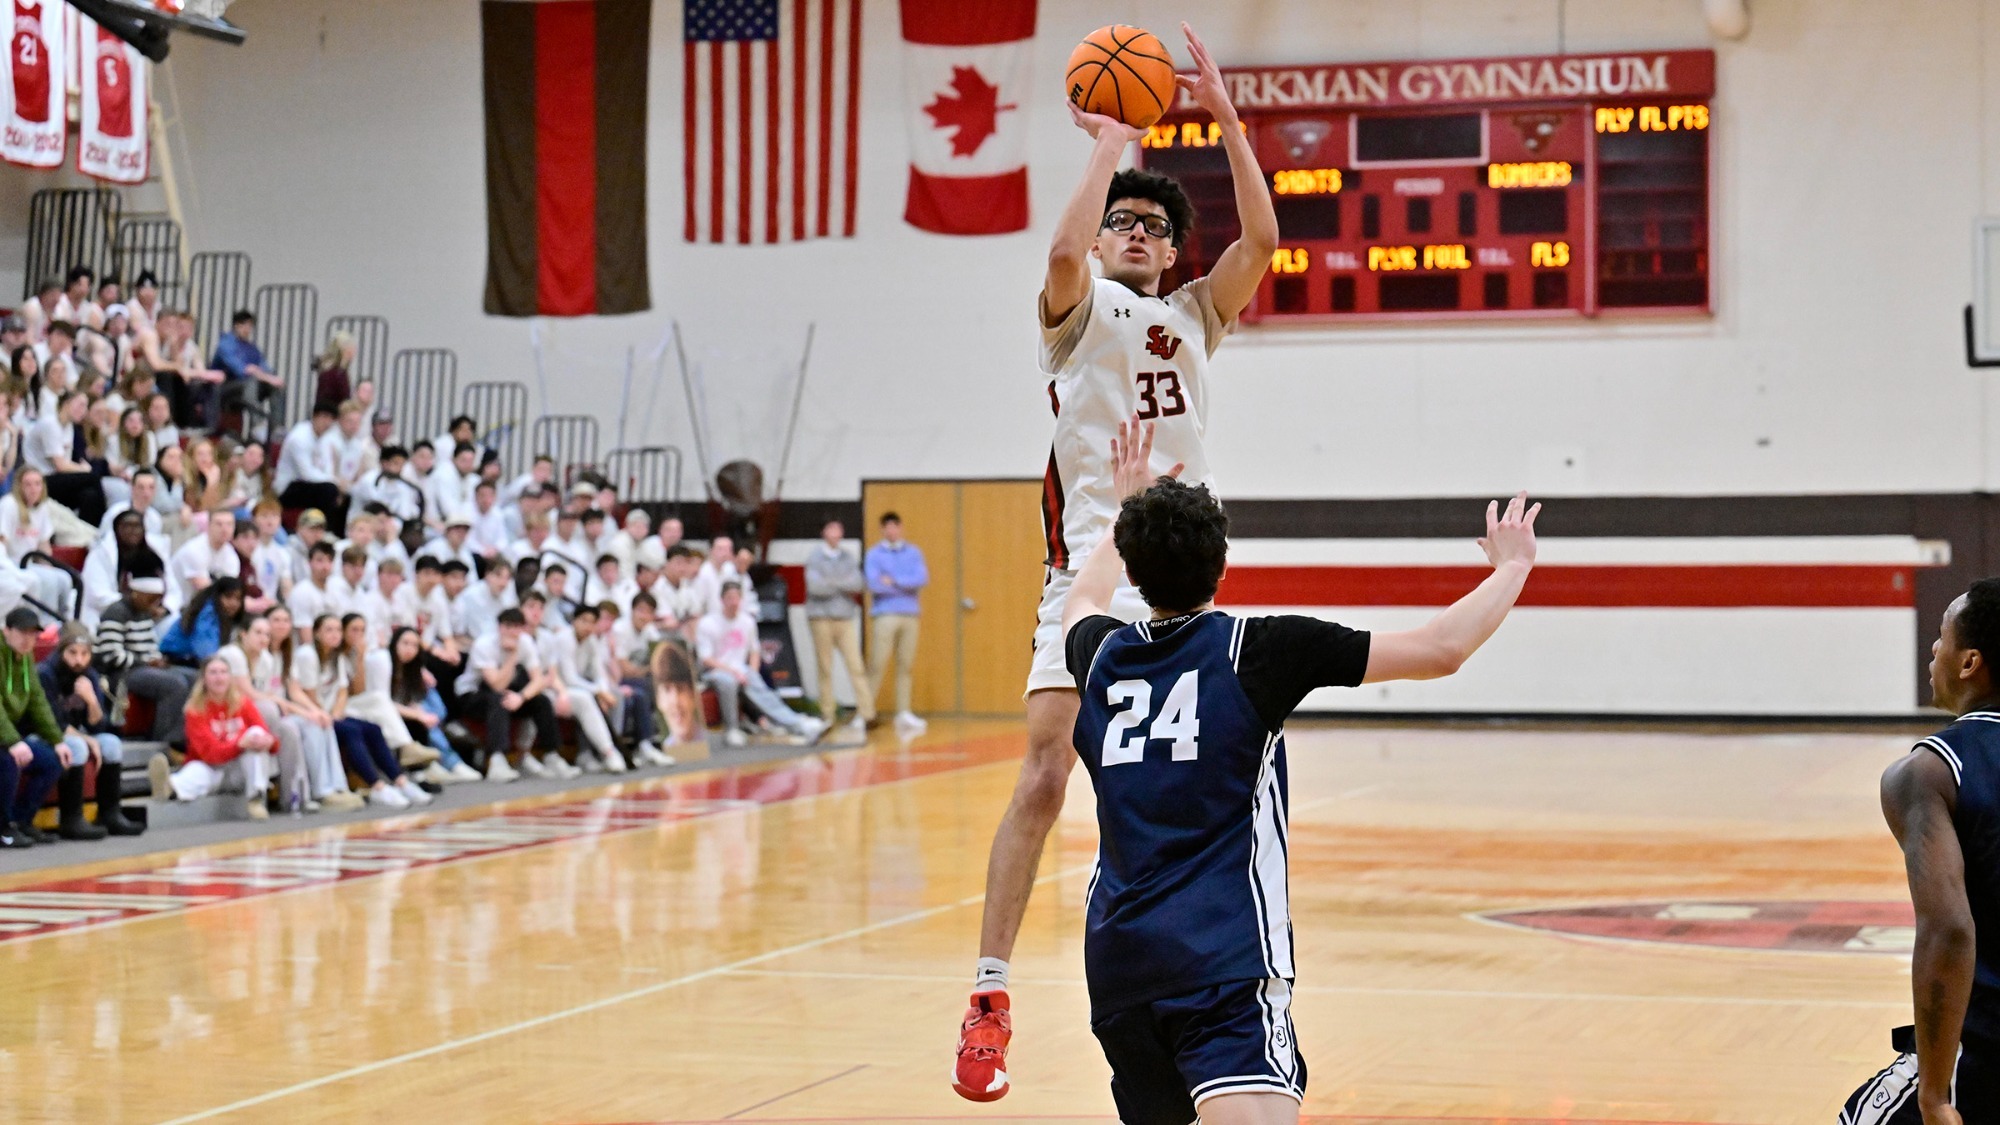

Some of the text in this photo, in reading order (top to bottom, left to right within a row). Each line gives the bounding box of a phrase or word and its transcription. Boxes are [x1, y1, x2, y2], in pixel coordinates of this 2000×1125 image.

[1399, 56, 1670, 100] GYMNASIUM
[1667, 105, 1709, 131] PTS
[1271, 248, 1309, 273] FLS
[1532, 241, 1570, 267] FLS
[1136, 371, 1186, 420] 33
[1151, 615, 1190, 628] NIKE PRO
[1102, 669, 1200, 767] 24
